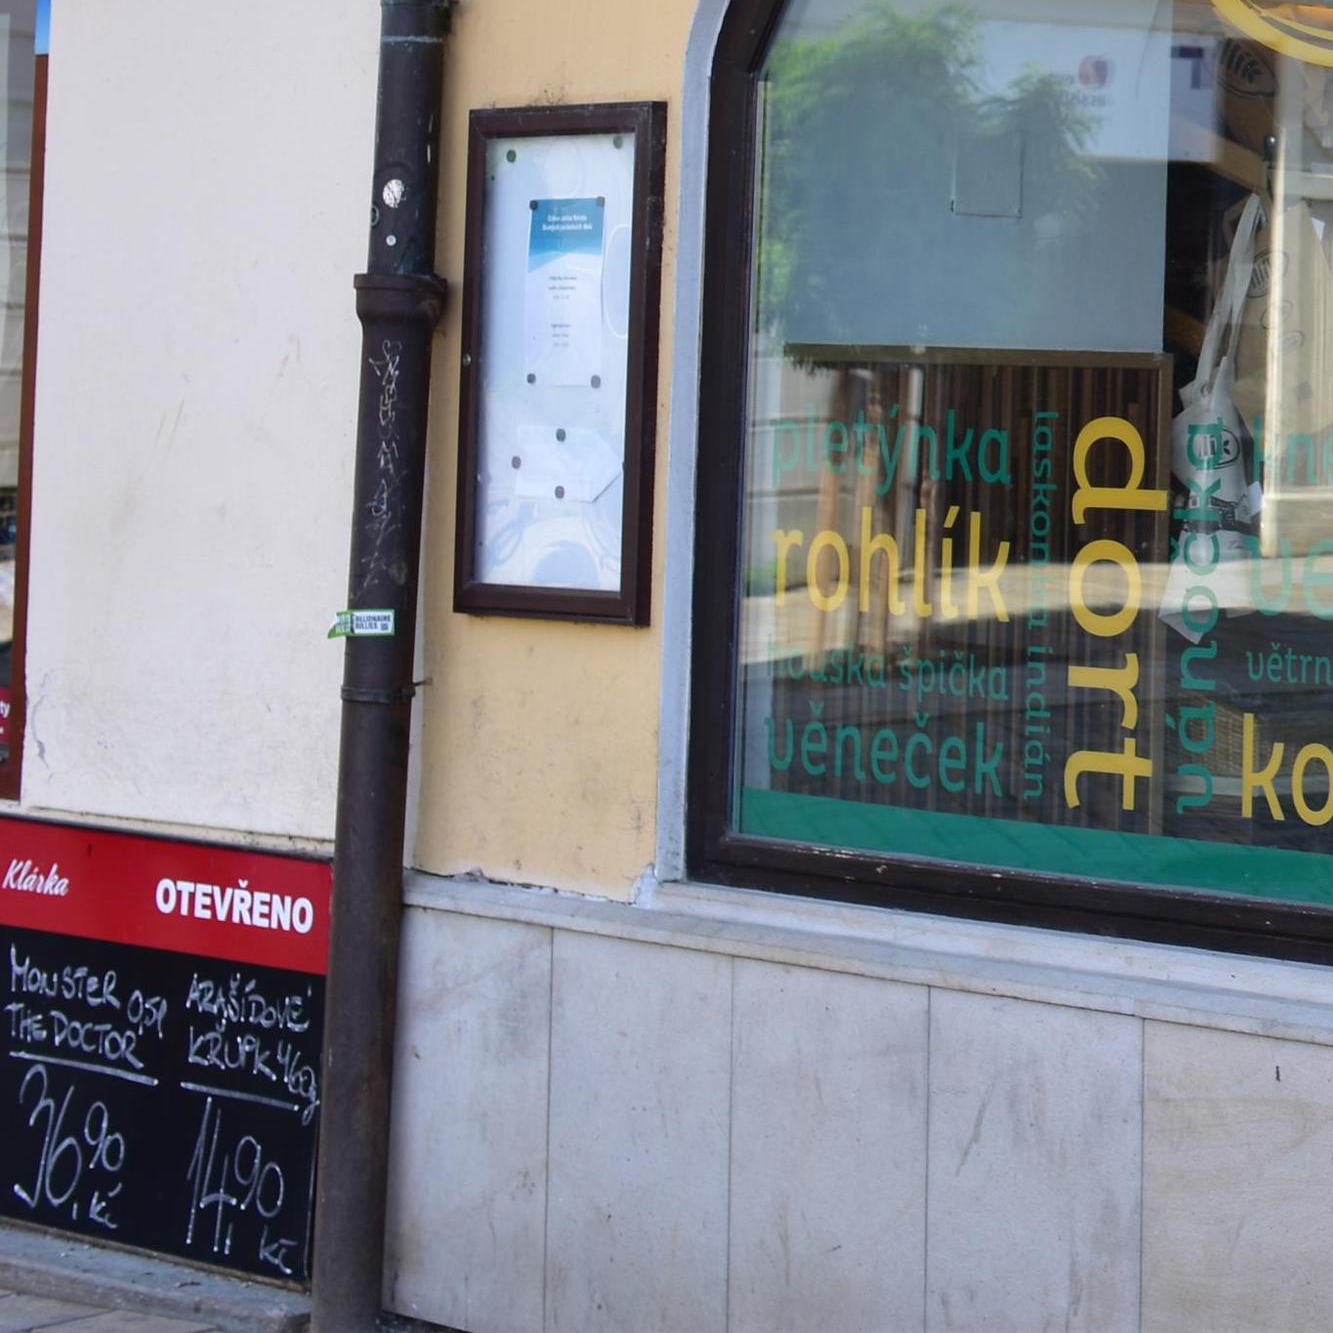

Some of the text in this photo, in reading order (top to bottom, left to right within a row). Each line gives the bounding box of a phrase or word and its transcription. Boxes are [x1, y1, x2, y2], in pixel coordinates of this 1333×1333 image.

[771, 403, 1012, 497] pletýnka
[771, 505, 1011, 623] rohlík
[1062, 415, 1169, 811] dort
[1168, 415, 1224, 815] vánočka
[899, 643, 1010, 703] špička
[763, 700, 1003, 797] věneček
[1022, 645, 1056, 800] indián
[2, 859, 70, 897] Klárka
[155, 878, 314, 934] OTEVŘENO
[9, 943, 118, 1009] MONSTER
[4, 1001, 145, 1069] THE DOCTOR
